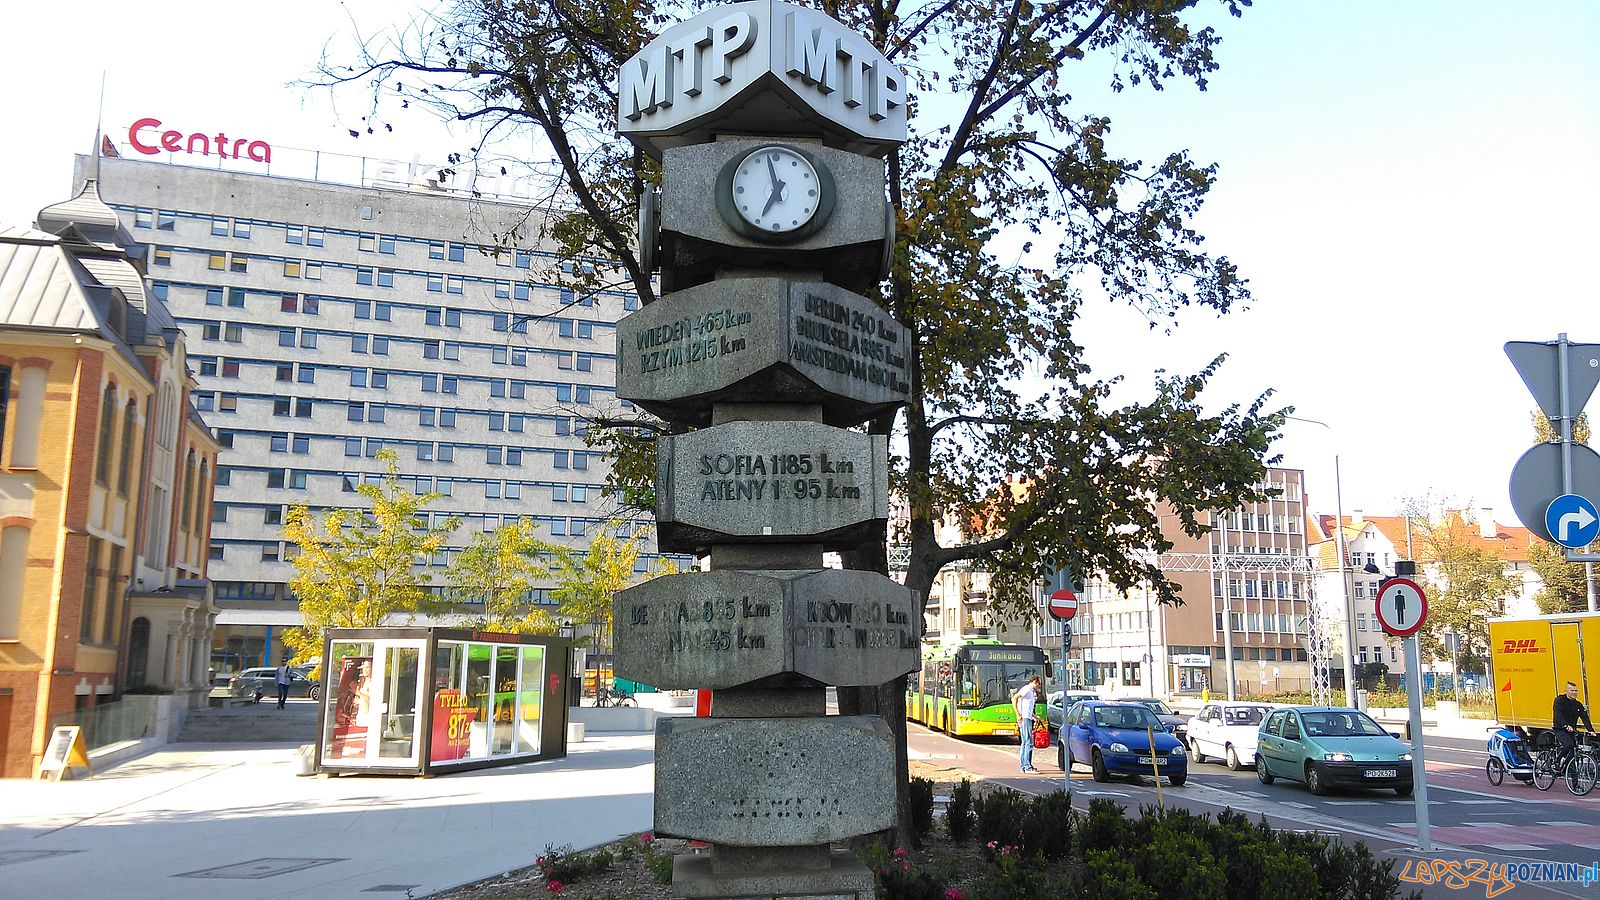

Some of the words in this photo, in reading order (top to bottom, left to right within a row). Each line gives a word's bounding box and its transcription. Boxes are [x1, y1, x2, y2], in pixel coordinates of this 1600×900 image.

[624, 11, 758, 121] MTP
[786, 11, 904, 121] MTP
[129, 118, 271, 163] Centra
[693, 310, 725, 335] 465
[726, 309, 751, 329] km
[804, 292, 850, 326] BERLIN
[852, 310, 875, 335] 240
[878, 320, 897, 344] km
[641, 346, 683, 374] RZYM
[685, 336, 718, 363] 1215
[721, 334, 746, 355] km
[885, 345, 904, 369] km
[788, 340, 867, 381] AMSTERDAM
[889, 371, 910, 395] km
[700, 454, 767, 475] SOFIA
[770, 454, 812, 475] 1185
[820, 453, 854, 473] km
[700, 479, 767, 500] ATENY
[826, 478, 861, 499] km
[742, 596, 771, 618] km
[886, 603, 908, 624] km
[737, 625, 766, 650] km
[899, 627, 920, 650] km
[1503, 639, 1540, 654] DHL
